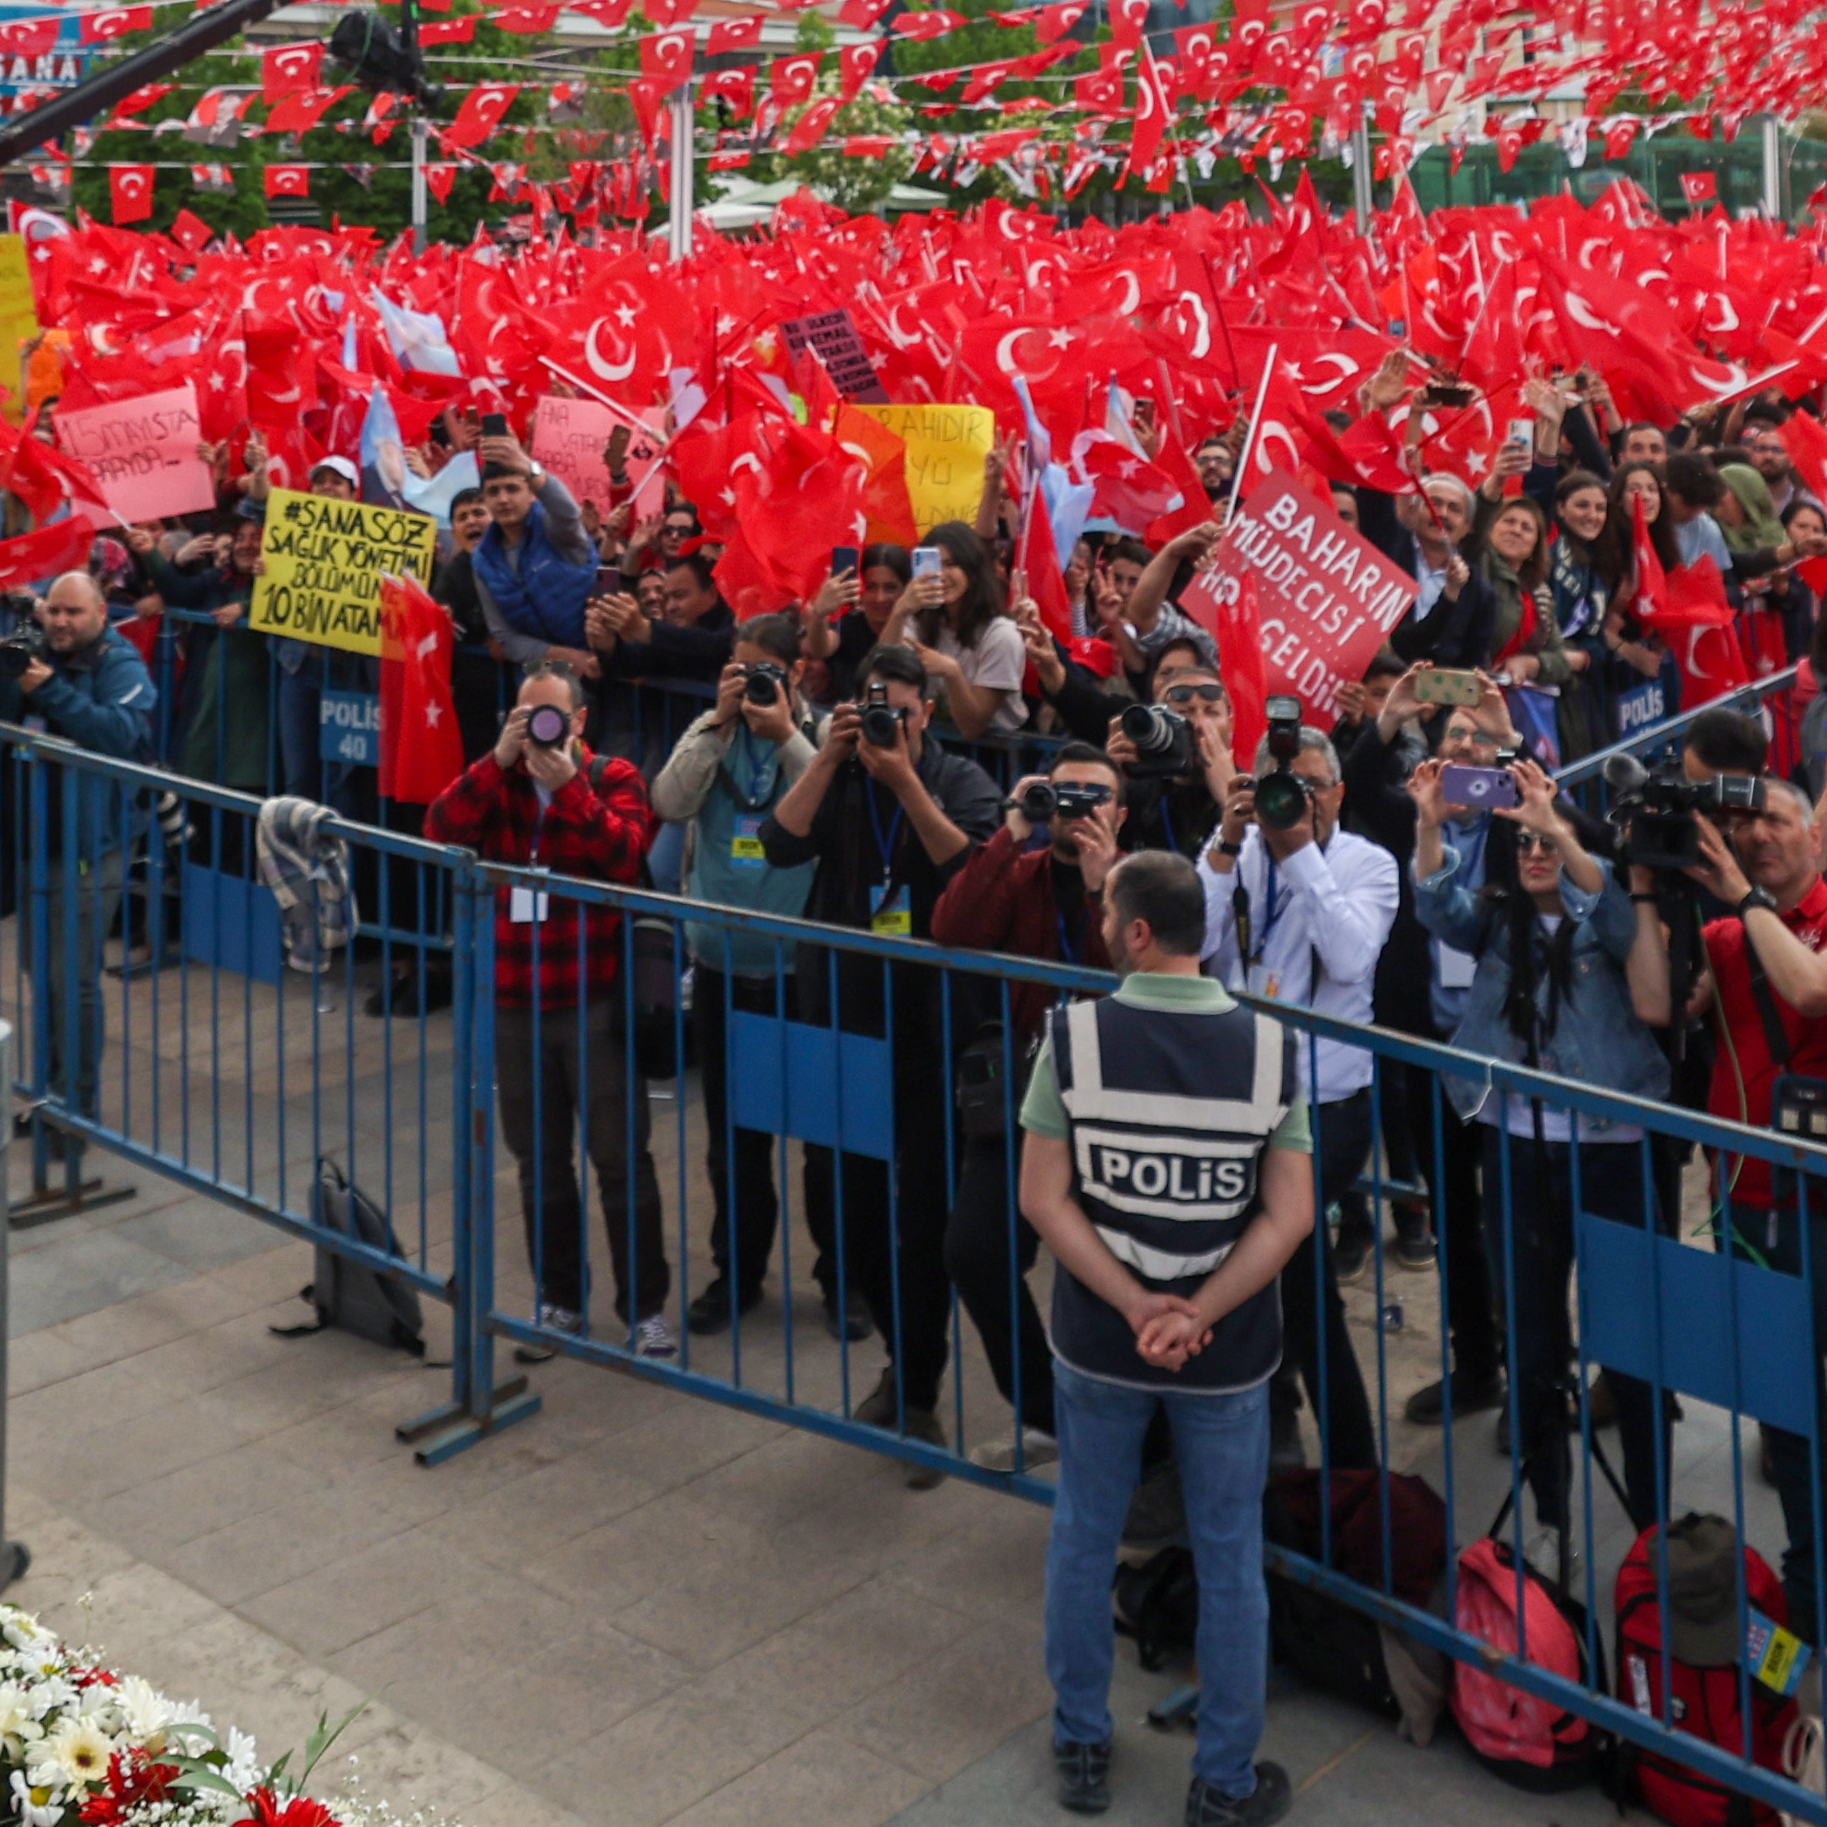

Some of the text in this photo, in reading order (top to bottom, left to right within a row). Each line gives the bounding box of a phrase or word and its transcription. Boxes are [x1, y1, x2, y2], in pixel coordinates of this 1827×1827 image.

[265, 525, 340, 564] SAĞLIK
[1263, 492, 1413, 634] BAHARIN
[1225, 511, 1366, 647] MÜJDECİSİ
[260, 583, 292, 626] 10
[294, 592, 334, 636] BİN
[320, 699, 387, 731] POLİS
[1620, 686, 1665, 731] POLİS
[339, 733, 369, 762] 40
[1100, 1149, 1246, 1200] POLİS
